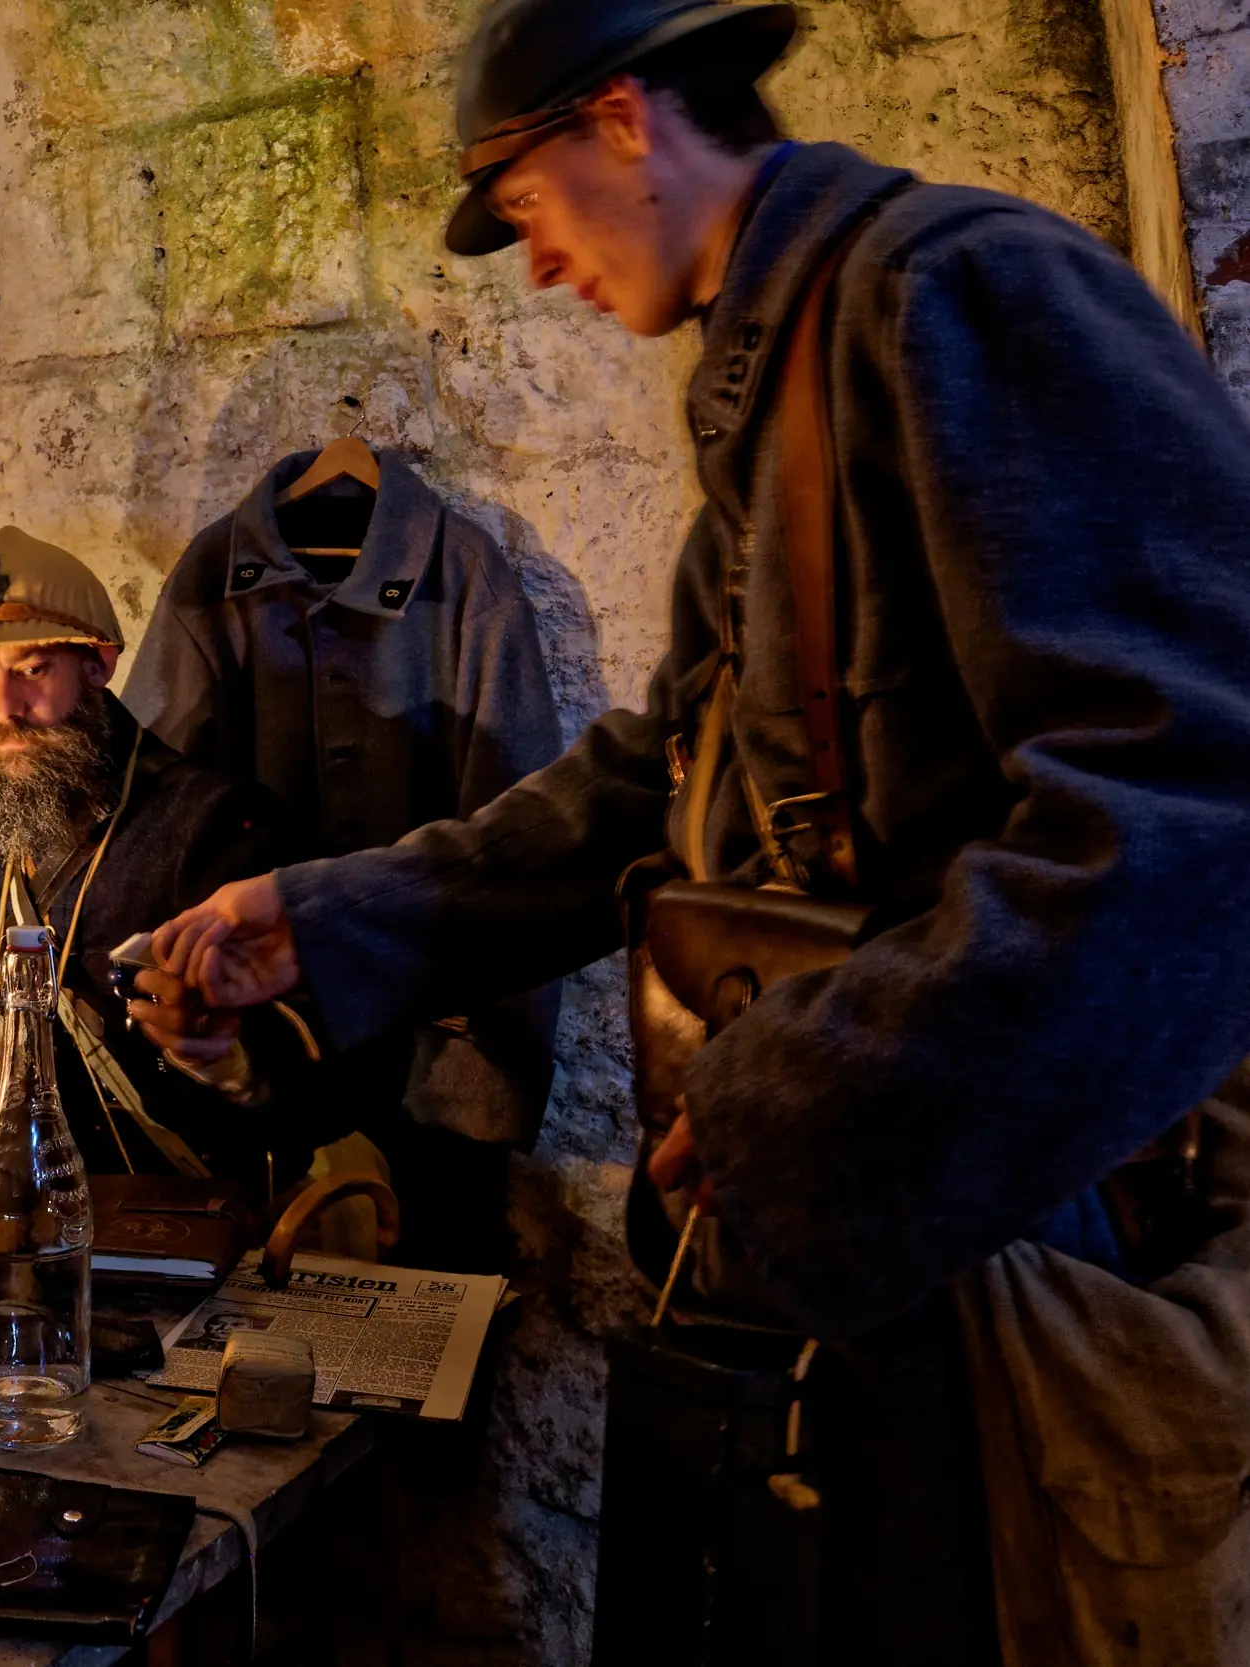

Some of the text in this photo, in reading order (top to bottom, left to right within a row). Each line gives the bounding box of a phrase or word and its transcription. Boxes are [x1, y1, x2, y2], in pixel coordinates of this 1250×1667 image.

[287, 1271, 398, 1292] risien
[324, 1294, 341, 1302] EST
[342, 1297, 370, 1305] MORT
